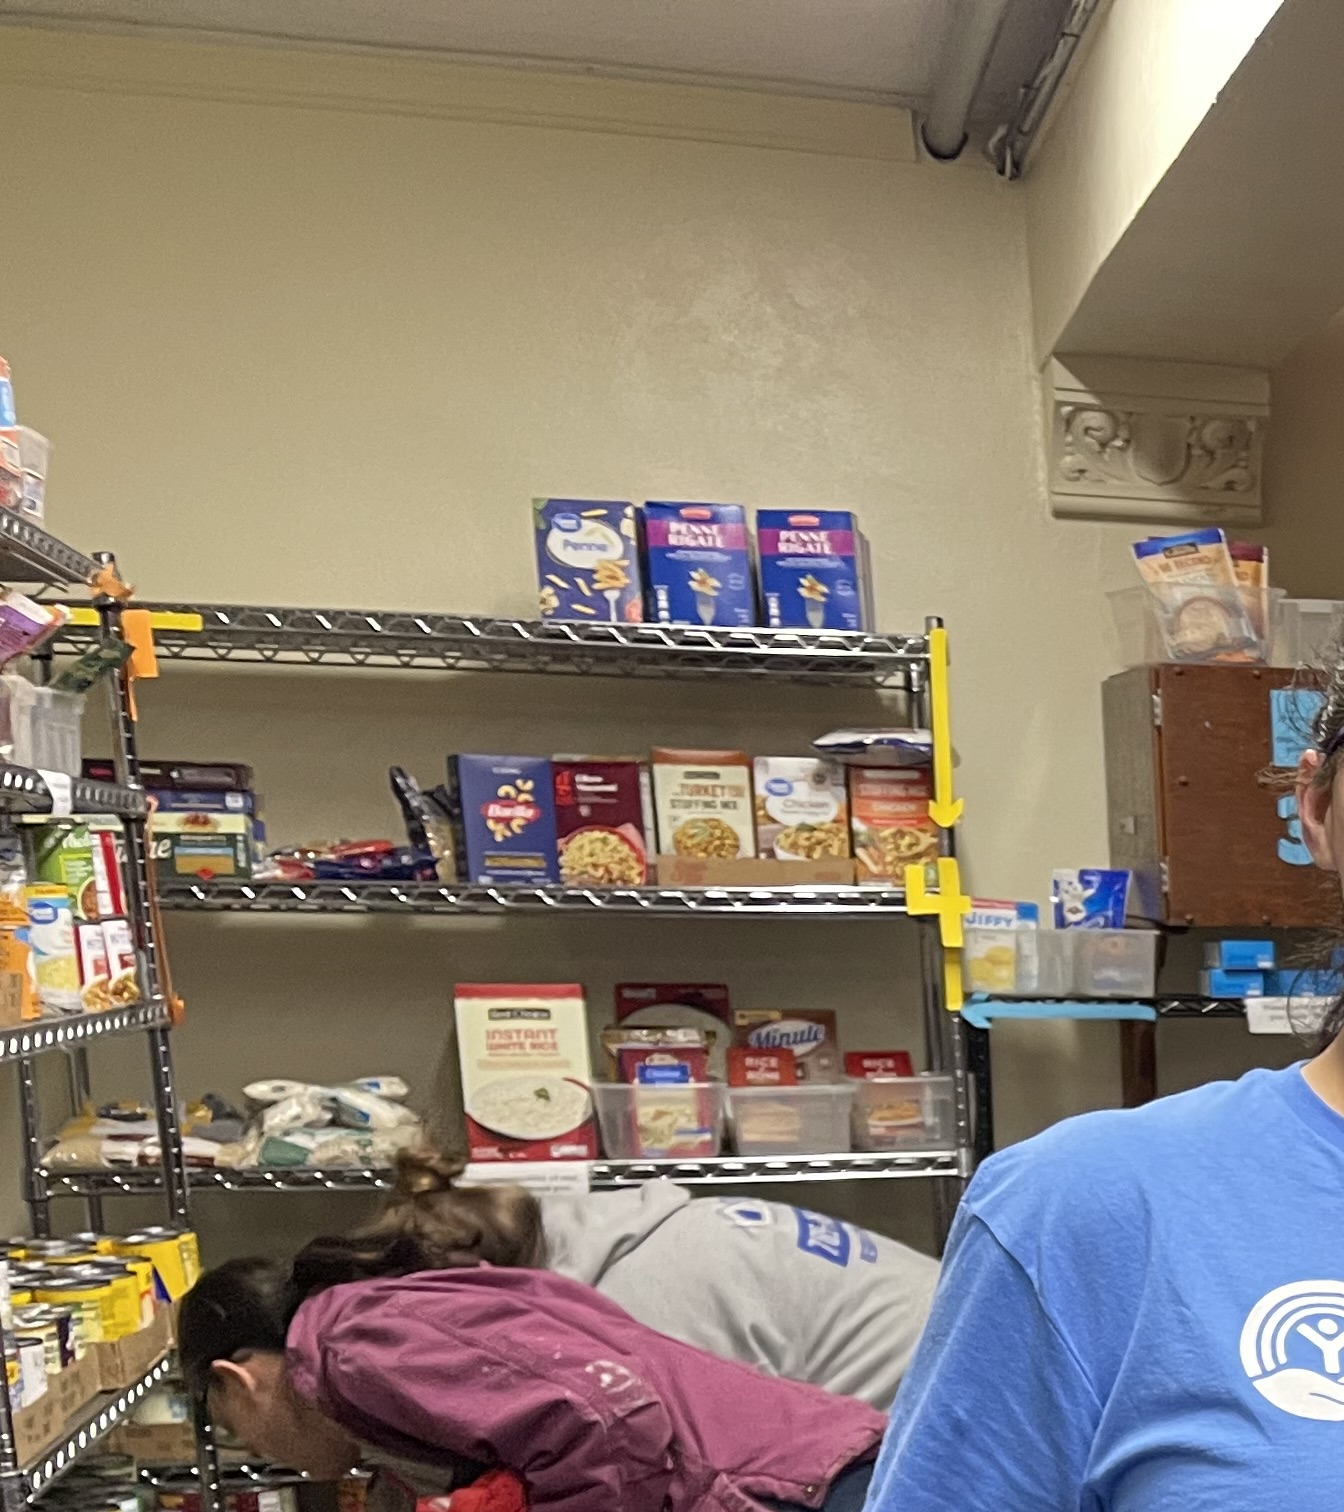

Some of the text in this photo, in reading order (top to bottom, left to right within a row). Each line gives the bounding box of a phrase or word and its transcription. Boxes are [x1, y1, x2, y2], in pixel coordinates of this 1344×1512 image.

[669, 521, 720, 535] PENNE
[668, 534, 725, 547] RIGATE
[779, 530, 830, 543] PENNE
[777, 541, 833, 554] RIGATE
[965, 912, 1013, 926] JIFFY
[486, 1028, 558, 1041] INSTANT
[751, 1022, 826, 1050] Minute
